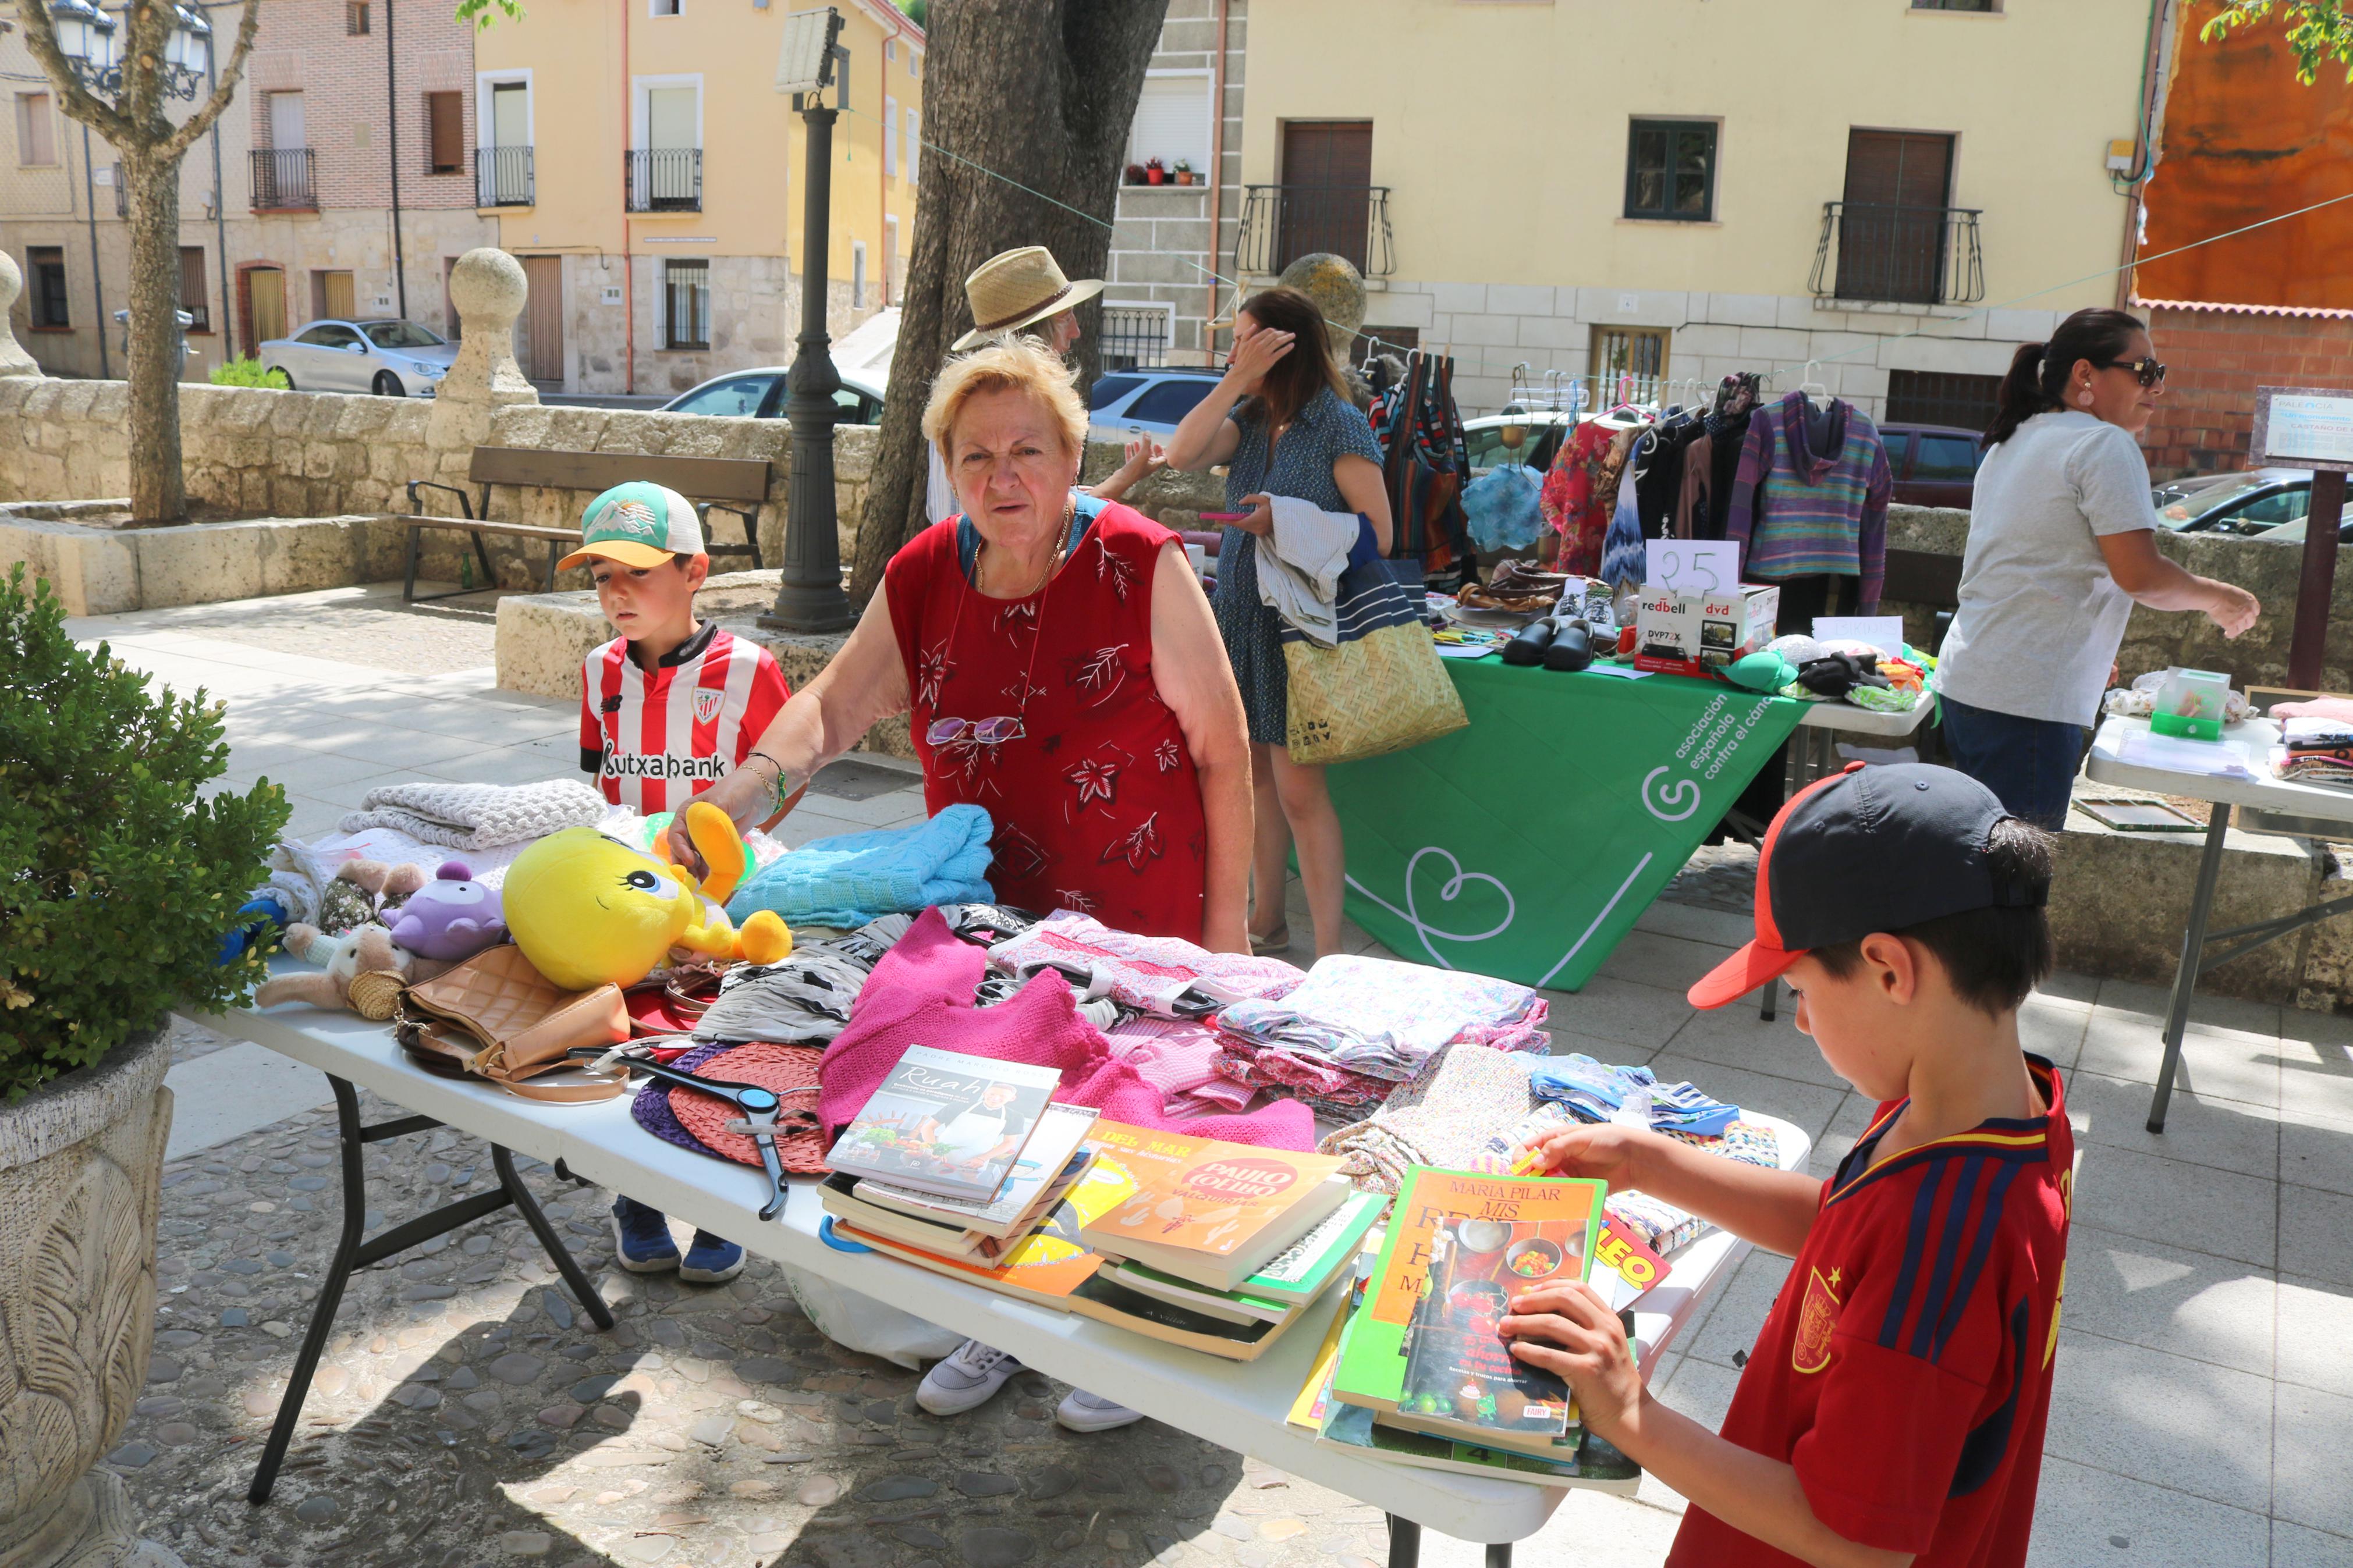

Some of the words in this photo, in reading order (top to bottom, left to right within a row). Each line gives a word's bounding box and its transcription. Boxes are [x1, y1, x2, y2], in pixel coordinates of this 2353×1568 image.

[1642, 598, 1686, 614] redbell
[1705, 603, 1730, 616] dvd
[1648, 630, 1681, 641] DVP72X
[1675, 694, 1728, 759] asociación
[1690, 712, 1736, 770] española
[1705, 739, 1739, 780] contra
[1735, 726, 1749, 740] el
[915, 1051, 951, 1062] PADRE
[957, 1059, 1009, 1072] MARCELO
[1015, 1069, 1050, 1079] ROSSI
[899, 1066, 981, 1094] Ruah
[1100, 1130, 1138, 1147] DEL
[1145, 1140, 1191, 1157] MAR
[1137, 1150, 1183, 1164] historias
[1204, 1163, 1291, 1186] PAULO
[1189, 1174, 1277, 1196] COELHO
[1449, 1181, 1504, 1197] MARIA
[1509, 1187, 1560, 1200] PILAR
[1172, 1188, 1259, 1207] VALQUIRIAS
[1480, 1201, 1521, 1218] MIS
[1465, 1345, 1516, 1364] ahorro
[1449, 1366, 1470, 1374] Recetas
[1475, 1371, 1493, 1379] trucos
[1489, 1365, 1522, 1376] cocina
